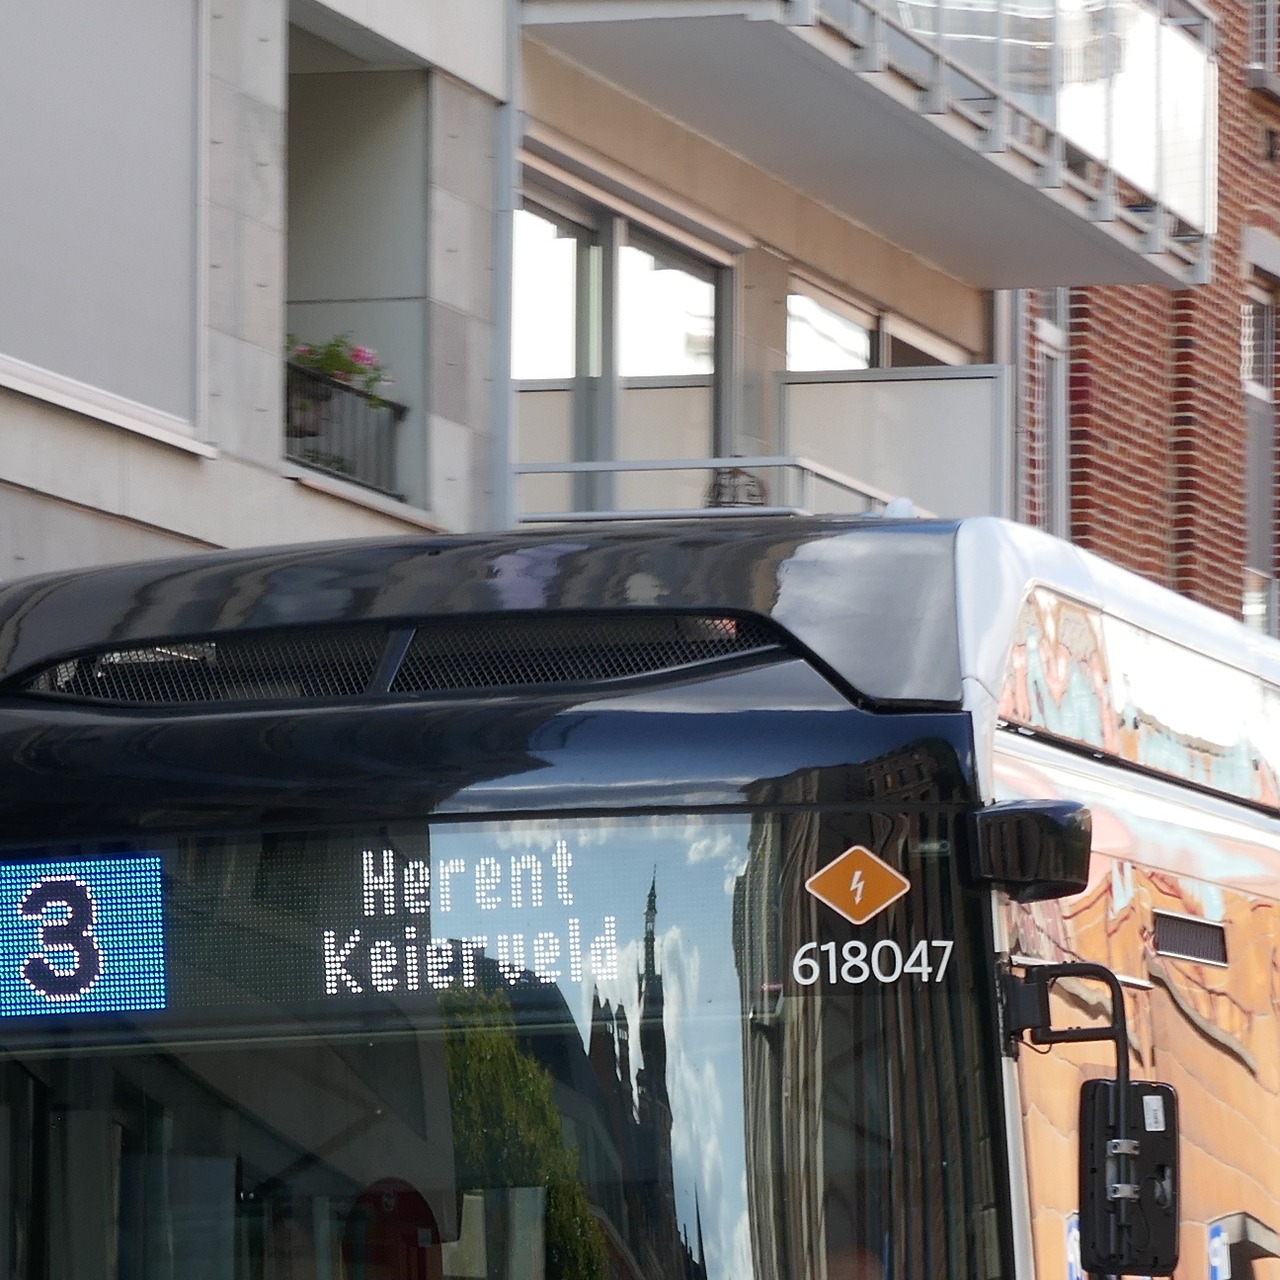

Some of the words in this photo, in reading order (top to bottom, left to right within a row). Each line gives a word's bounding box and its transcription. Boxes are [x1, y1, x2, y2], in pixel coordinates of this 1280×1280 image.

[361, 840, 574, 917] Herent
[17, 873, 106, 1003] 3
[322, 915, 619, 996] Keierveld
[792, 939, 955, 986] 618047
